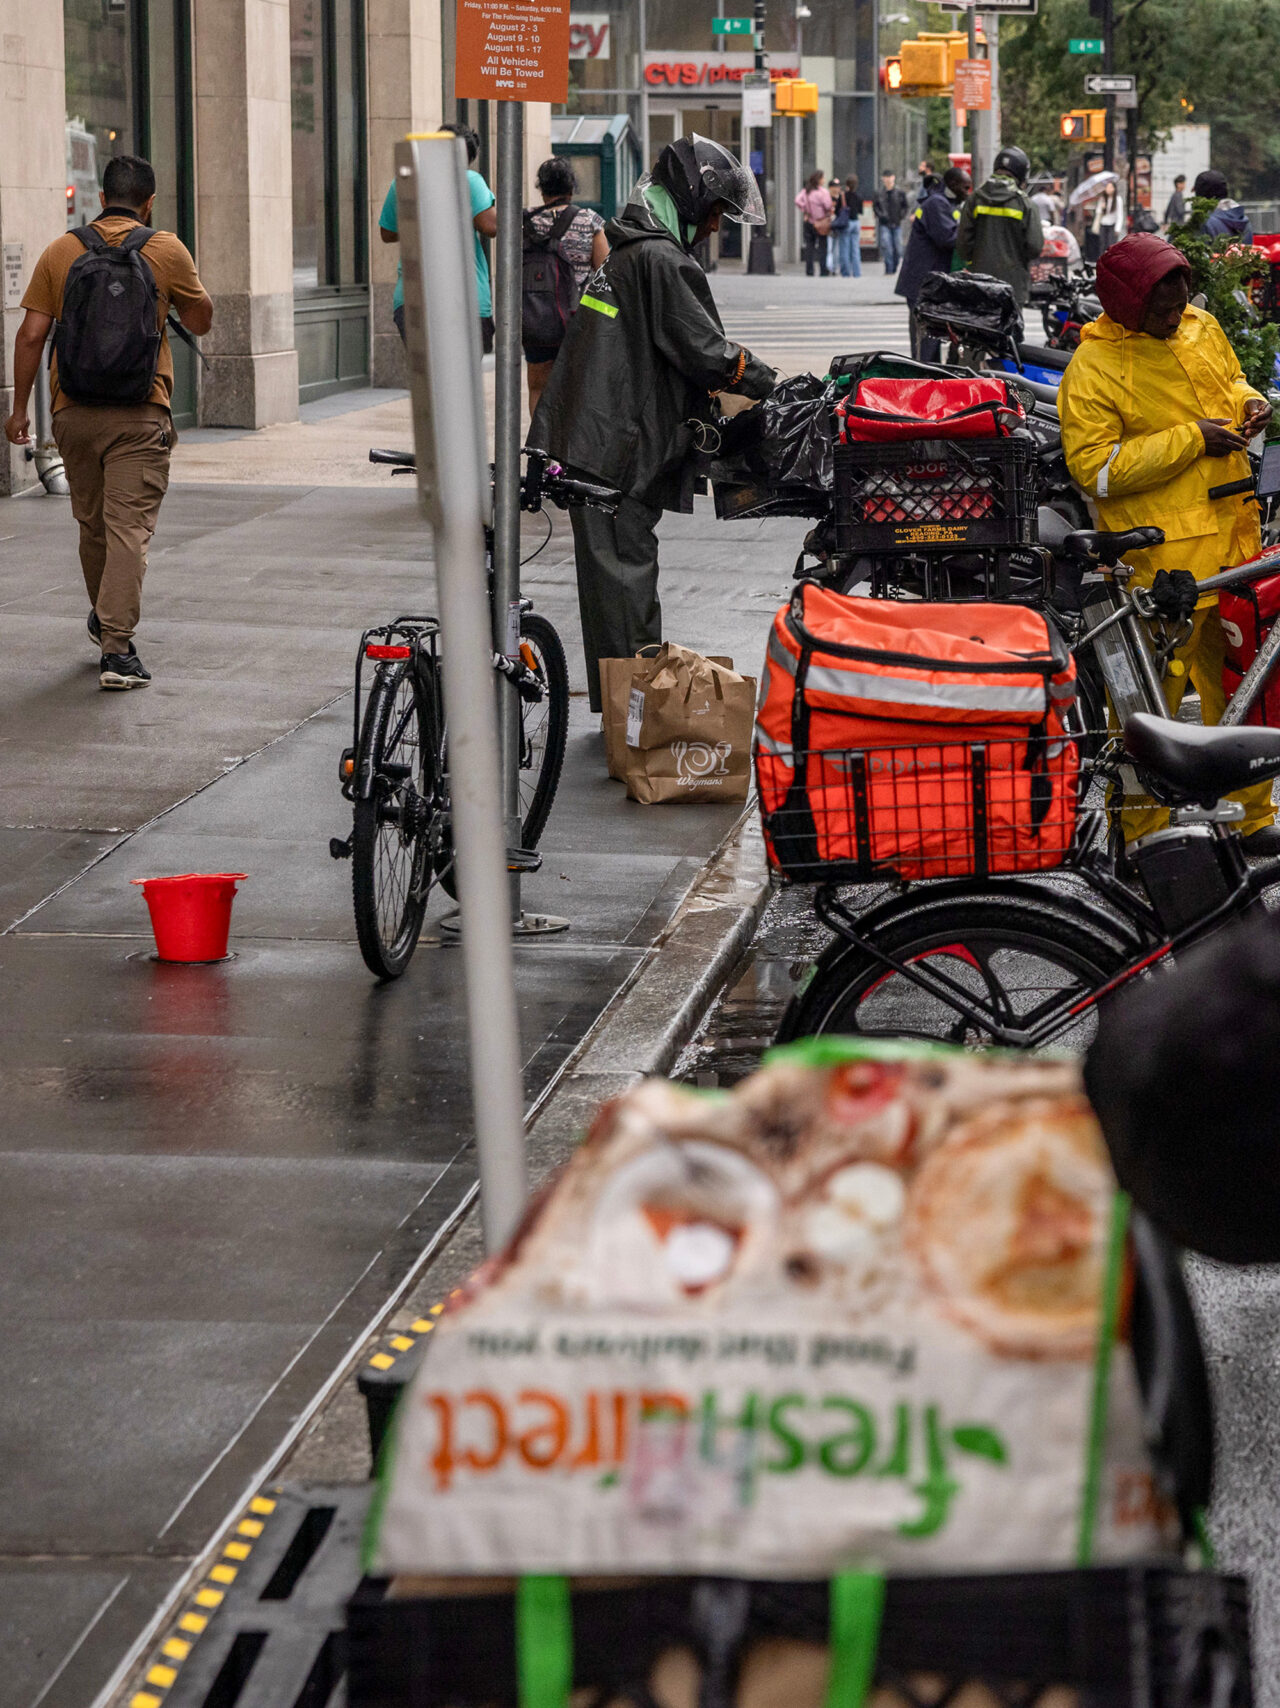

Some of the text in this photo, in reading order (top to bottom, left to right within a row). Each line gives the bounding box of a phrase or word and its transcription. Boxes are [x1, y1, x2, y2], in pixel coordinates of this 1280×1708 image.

[515, 5, 539, 13] Saturday,
[503, 14, 528, 22] Following
[490, 22, 518, 32] August
[520, 24, 526, 32] 2
[724, 20, 731, 32] 4
[487, 33, 516, 42] August
[518, 34, 523, 42] 9
[531, 35, 540, 43] 10
[484, 43, 513, 53] August
[516, 45, 525, 53] 16
[487, 56, 539, 67] All Vehicles
[480, 66, 545, 78] Will Be Towed
[496, 80, 514, 88] NYC
[676, 773, 723, 792] Wegmans
[716, 1333, 798, 1365] that
[808, 1335, 918, 1376] Food
